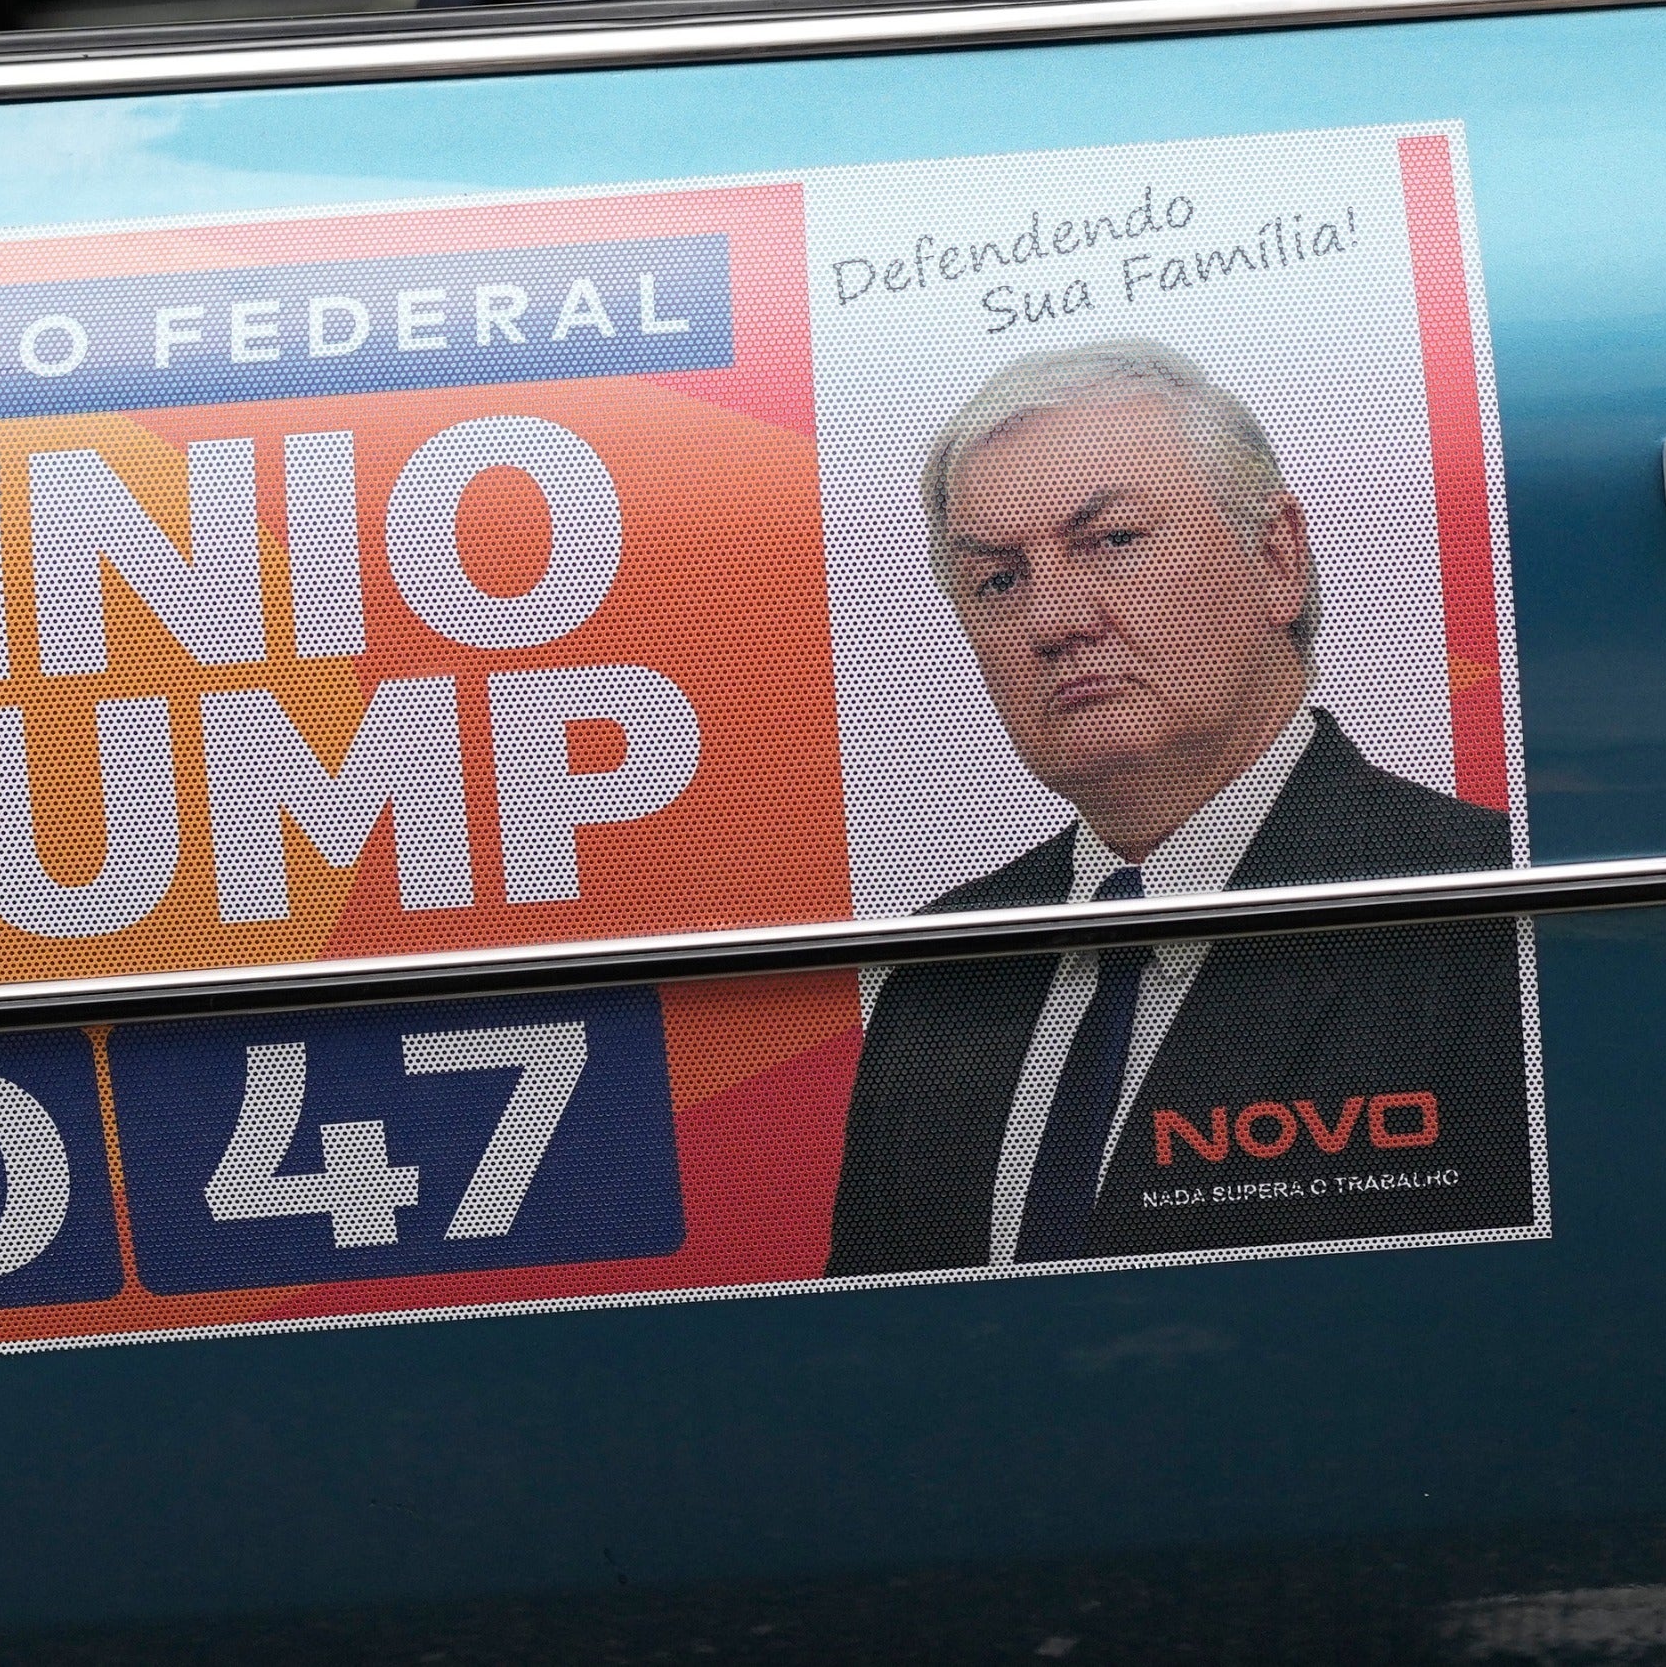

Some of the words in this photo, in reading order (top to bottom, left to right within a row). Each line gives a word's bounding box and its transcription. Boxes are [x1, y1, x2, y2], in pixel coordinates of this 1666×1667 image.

[830, 185, 1194, 305] Defendendo
[981, 278, 1094, 335] Sua
[1122, 205, 1360, 304] Família!
[153, 271, 691, 368] FEDERAL
[203, 1020, 589, 1249] 47
[1153, 1090, 1439, 1166] NOVO
[1142, 1186, 1206, 1209] NADA
[1212, 1180, 1302, 1203] SUPERA
[1311, 1177, 1328, 1196] O
[1334, 1168, 1460, 1193] TRABALHO
